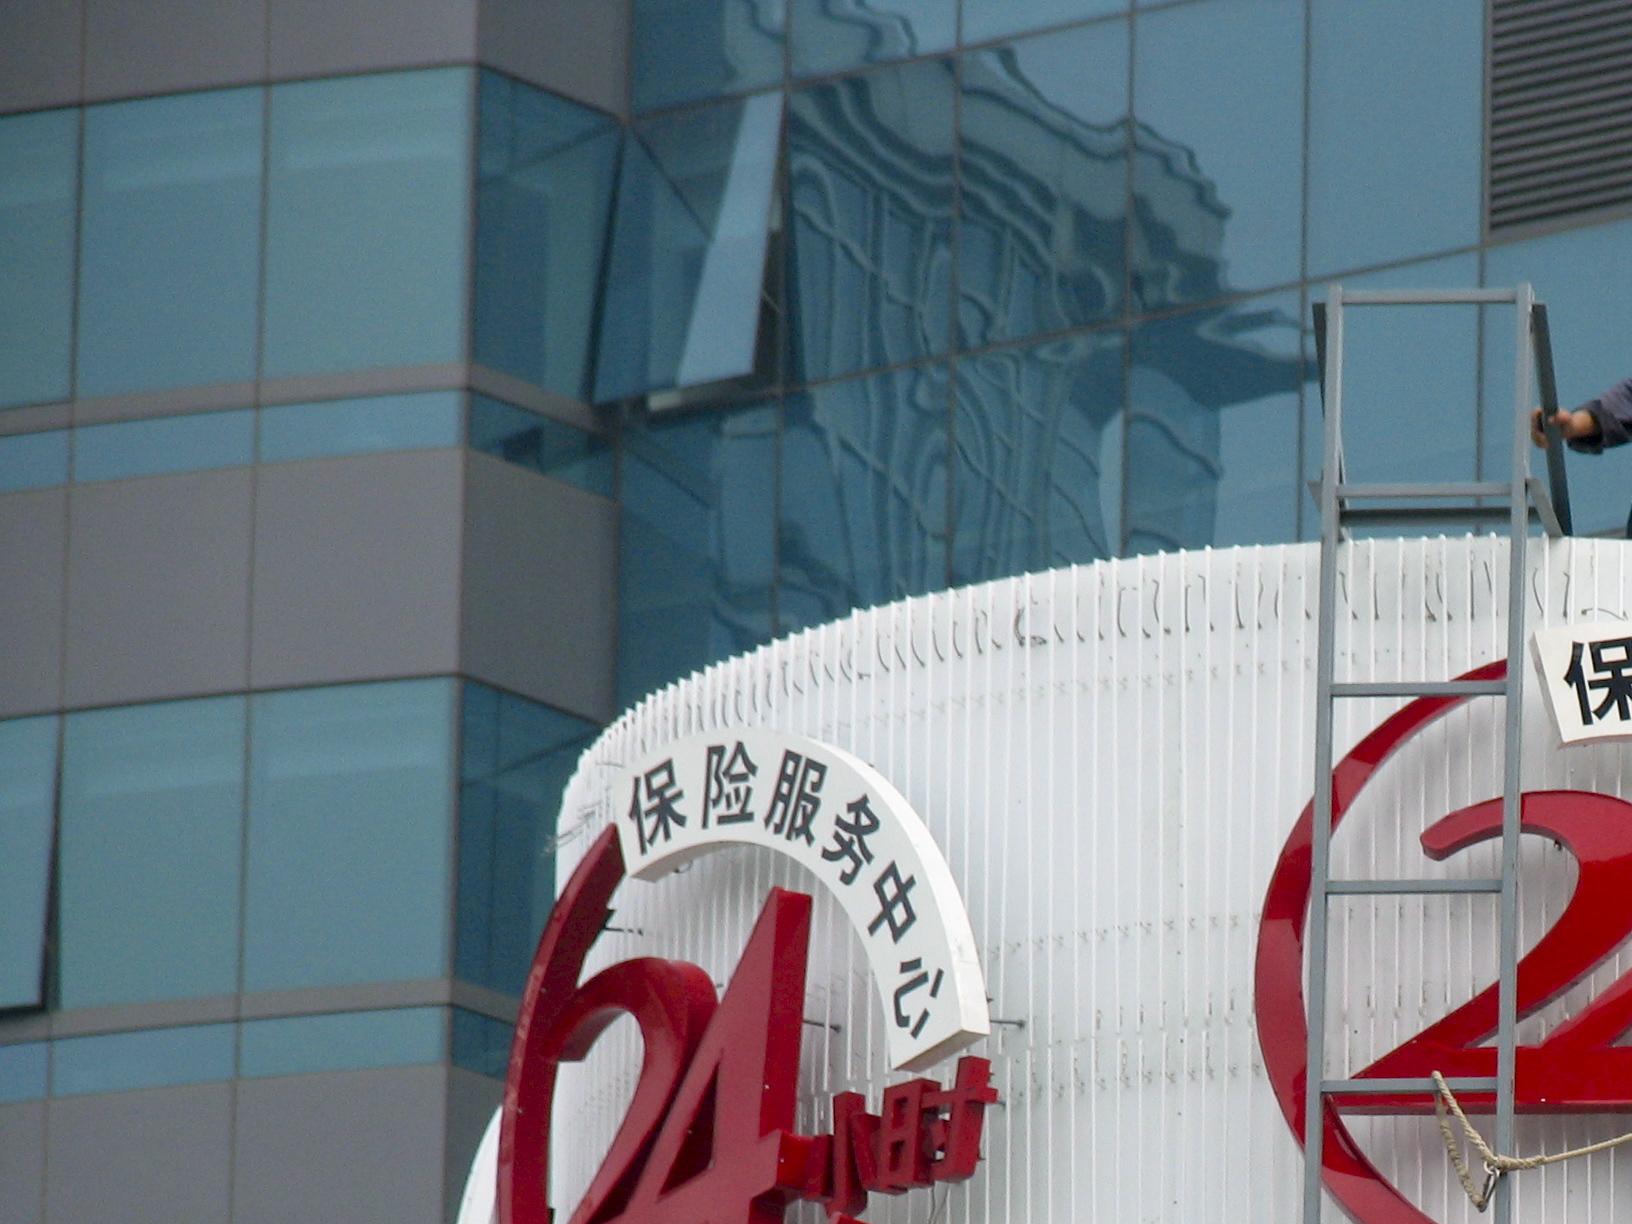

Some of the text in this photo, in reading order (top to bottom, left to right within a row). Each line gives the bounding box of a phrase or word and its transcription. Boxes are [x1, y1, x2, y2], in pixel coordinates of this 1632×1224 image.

[627, 739, 946, 1040] 保险服务中心
